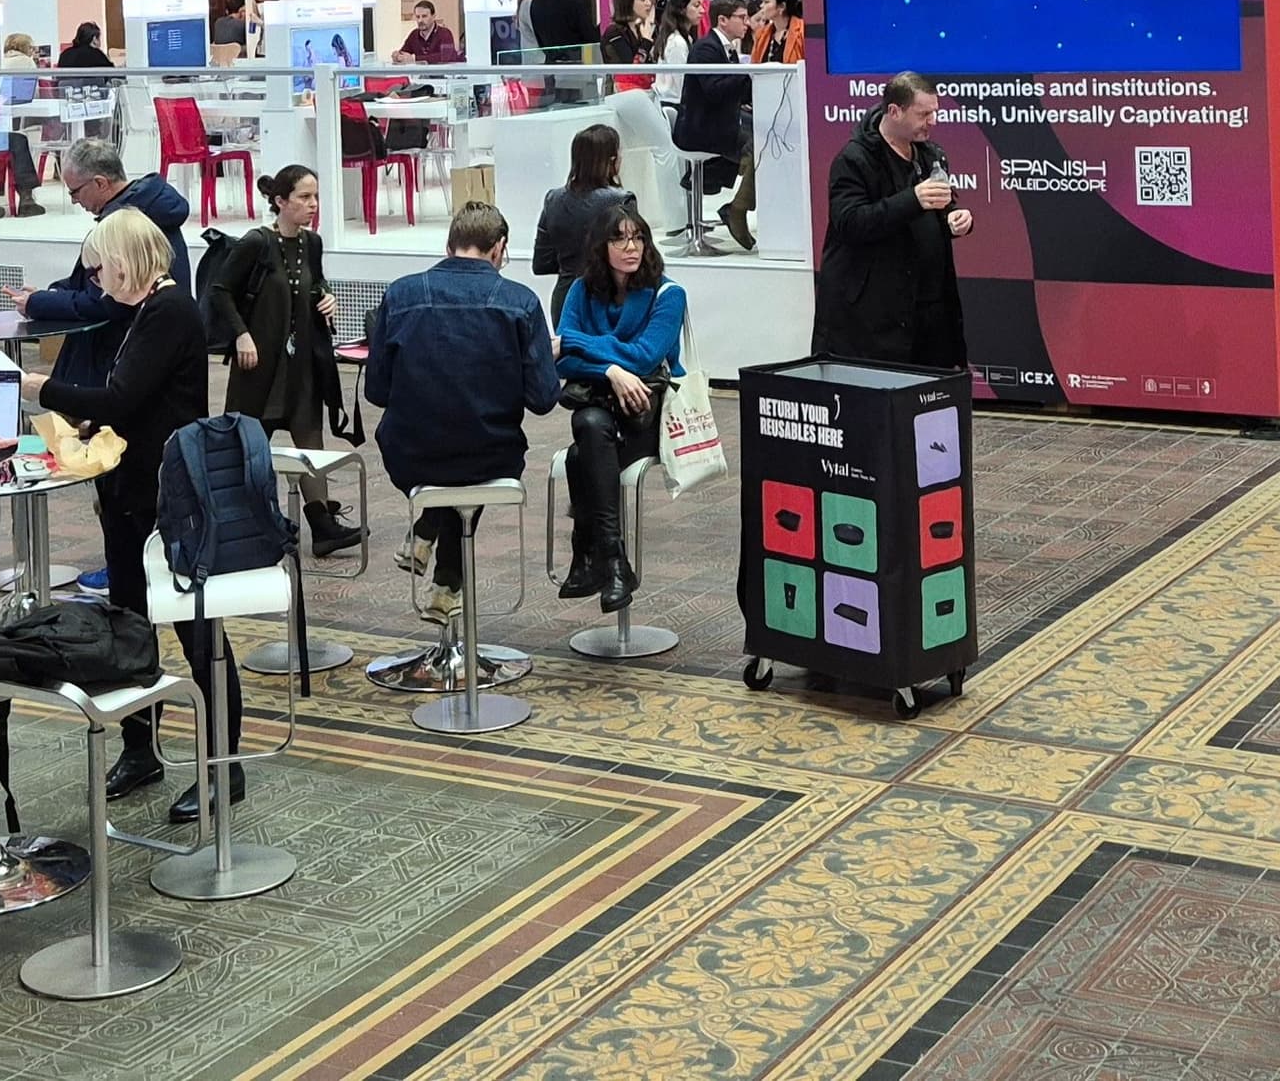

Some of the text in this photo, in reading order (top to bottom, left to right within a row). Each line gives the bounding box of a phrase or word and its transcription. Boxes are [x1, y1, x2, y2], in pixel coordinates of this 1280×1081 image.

[935, 78, 1218, 100] companies and institutions.
[934, 105, 997, 126] anish,
[1001, 106, 1115, 127] Universally
[1120, 106, 1249, 128] Captivating!
[1000, 160, 1106, 177] SPANISH
[1000, 177, 1107, 192] KALEIDOSCOPE
[759, 397, 829, 425] RETURN YOUR
[759, 416, 844, 449] REUSABLES HERE
[821, 459, 849, 477] Vytal
